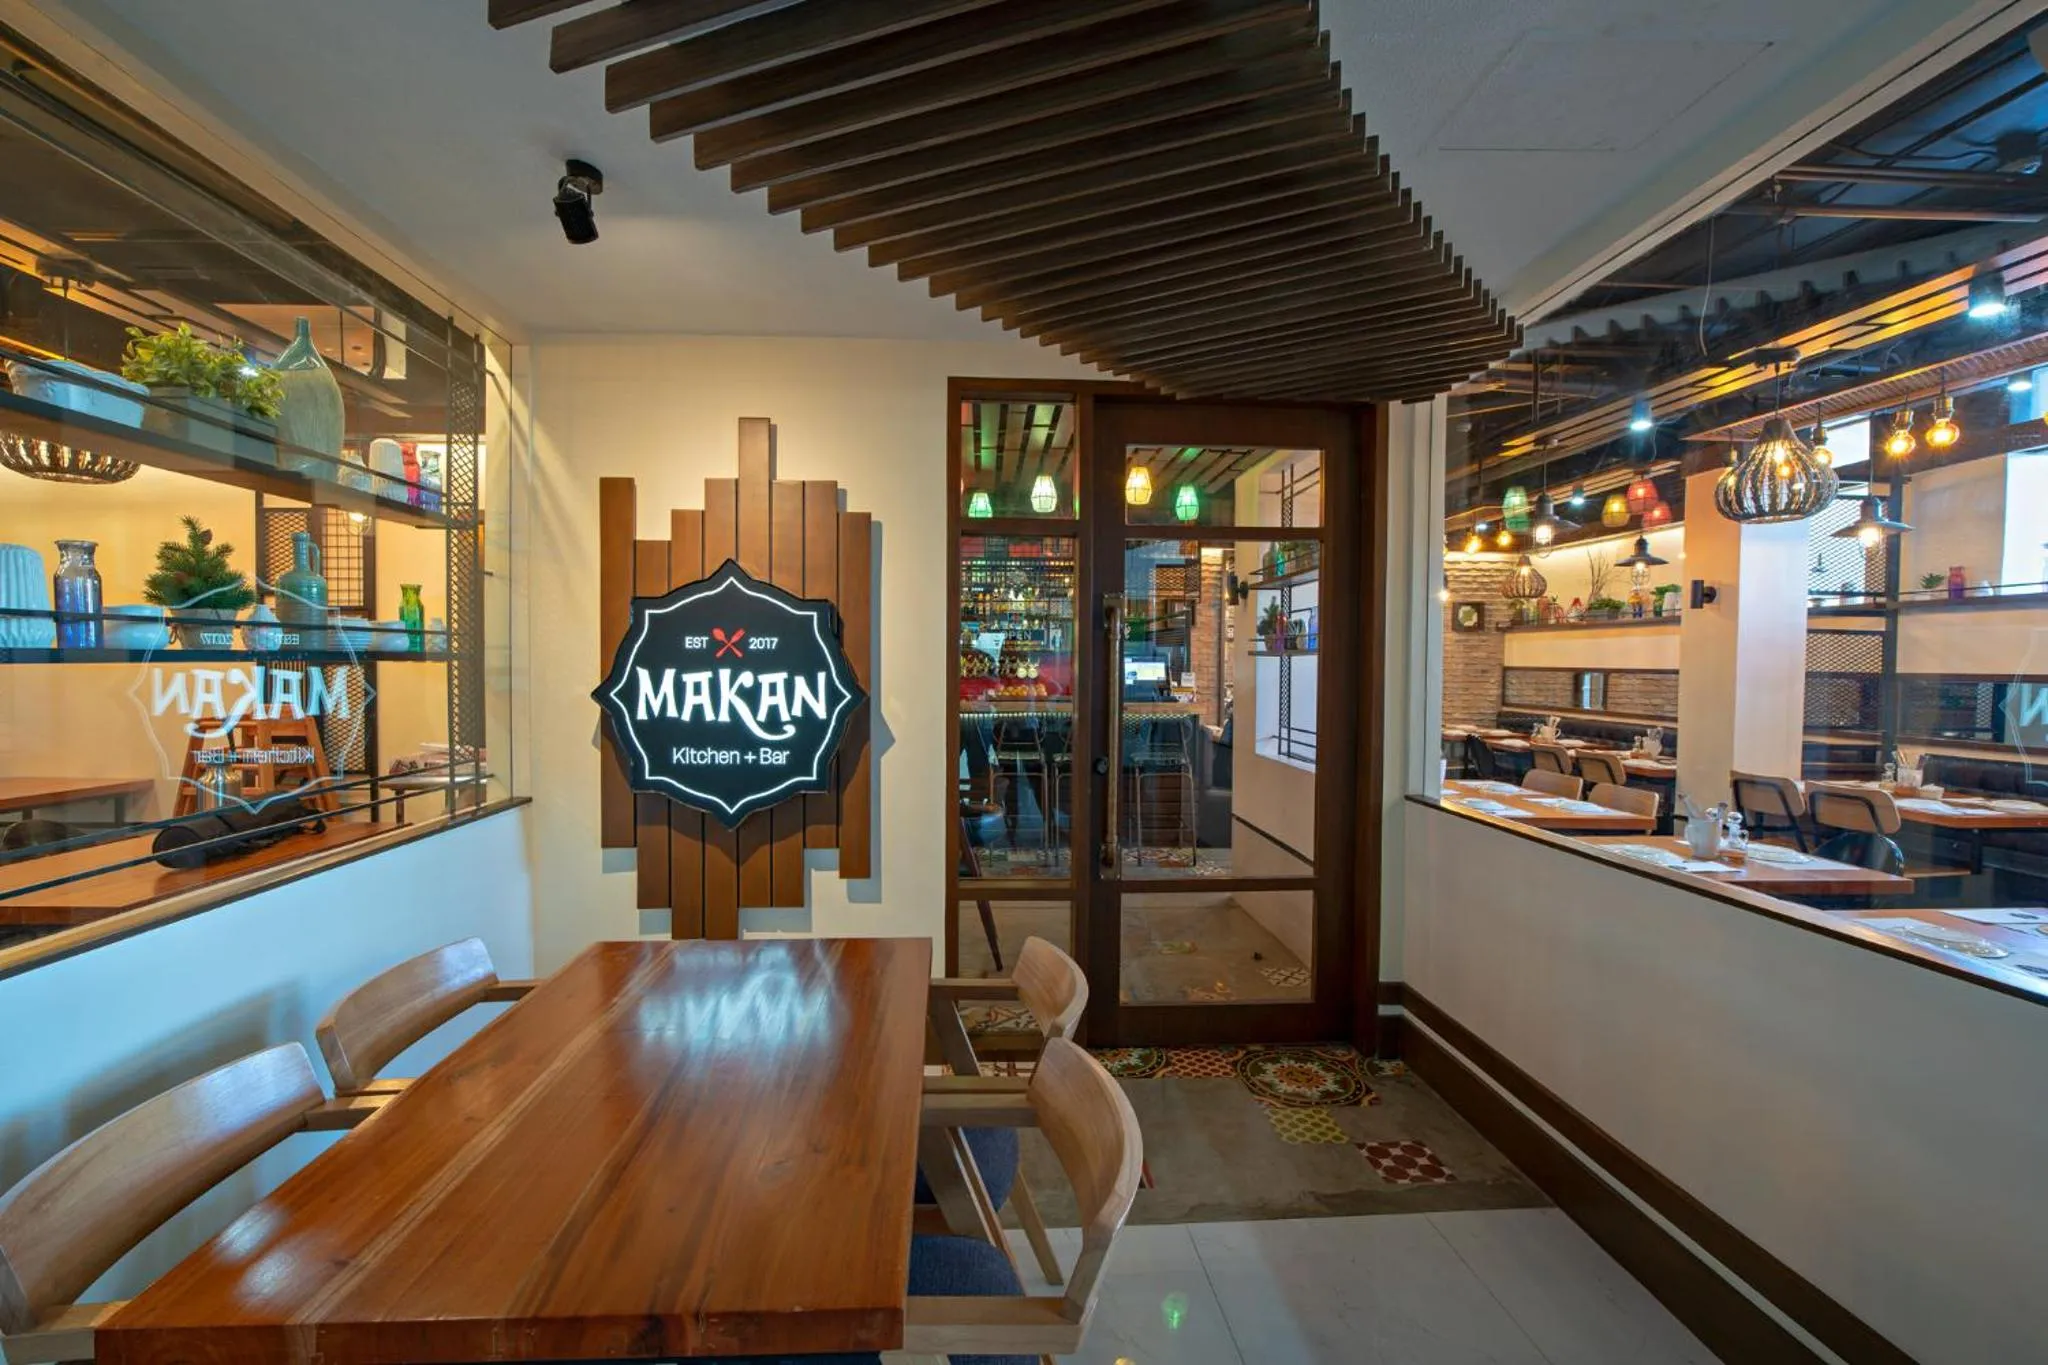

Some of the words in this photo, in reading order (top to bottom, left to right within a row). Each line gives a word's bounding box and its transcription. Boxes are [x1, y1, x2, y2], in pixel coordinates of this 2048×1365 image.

[684, 636, 709, 649] EST
[748, 637, 779, 650] 2017
[636, 666, 827, 740] MAKAN
[673, 747, 740, 764] Kitchen
[760, 747, 790, 764] Bar
